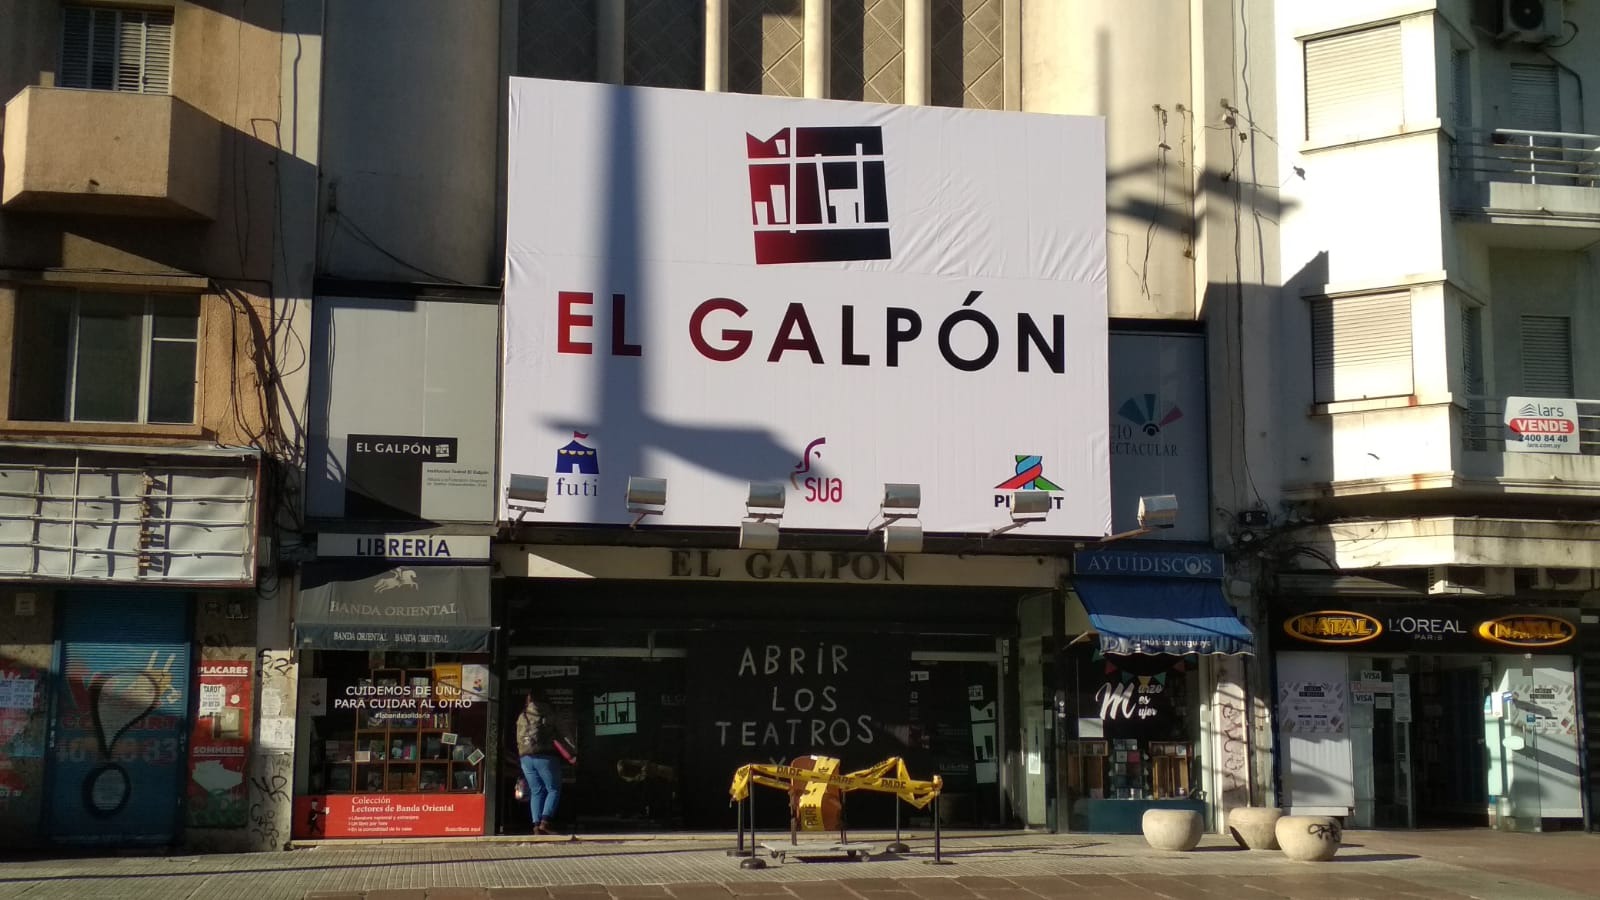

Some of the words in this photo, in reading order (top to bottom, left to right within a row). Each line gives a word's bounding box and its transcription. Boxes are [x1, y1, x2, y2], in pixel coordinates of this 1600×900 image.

[557, 291, 643, 357] EL
[688, 290, 1066, 375] GALPÓN
[1537, 403, 1565, 418] lars
[1516, 419, 1569, 433] VENDE
[1519, 434, 1542, 442] 2400
[1543, 434, 1555, 443] 84
[1557, 434, 1569, 443] 48
[356, 442, 372, 453] EL
[374, 441, 431, 455] GALPÓN
[556, 477, 599, 497] futi
[804, 476, 843, 503] sua
[356, 534, 451, 557] LIBRERÍA
[669, 550, 722, 578] EL
[330, 601, 382, 616] BANDA
[384, 602, 457, 616] ORIENTAL
[1298, 616, 1373, 636] NATAL
[1388, 616, 1468, 634] L'OREAL
[1494, 621, 1566, 640] NATAL
[333, 631, 356, 641] BANDA
[356, 632, 388, 642] ORIENTAL
[394, 633, 417, 643] BANDA
[418, 634, 449, 643] ORIENTAL
[198, 665, 249, 674] PLACARES
[1363, 671, 1381, 680] VISA
[345, 685, 411, 696] CUIDEMOS
[415, 686, 431, 696] DE
[435, 686, 461, 696] UNO
[334, 699, 366, 709] PARA
[369, 699, 417, 709] CUIDAR
[420, 699, 436, 709] AL
[438, 699, 472, 709] OTRO
[772, 686, 838, 712] LOS
[1355, 694, 1373, 702] VISA
[715, 715, 874, 748] TEATROS
[776, 765, 804, 778] PARE
[880, 779, 907, 790] PARE
[351, 796, 391, 805] Colección
[351, 804, 384, 813] Lectores
[384, 804, 395, 812] de
[396, 804, 421, 812] Banda
[422, 804, 454, 812] Oriental
